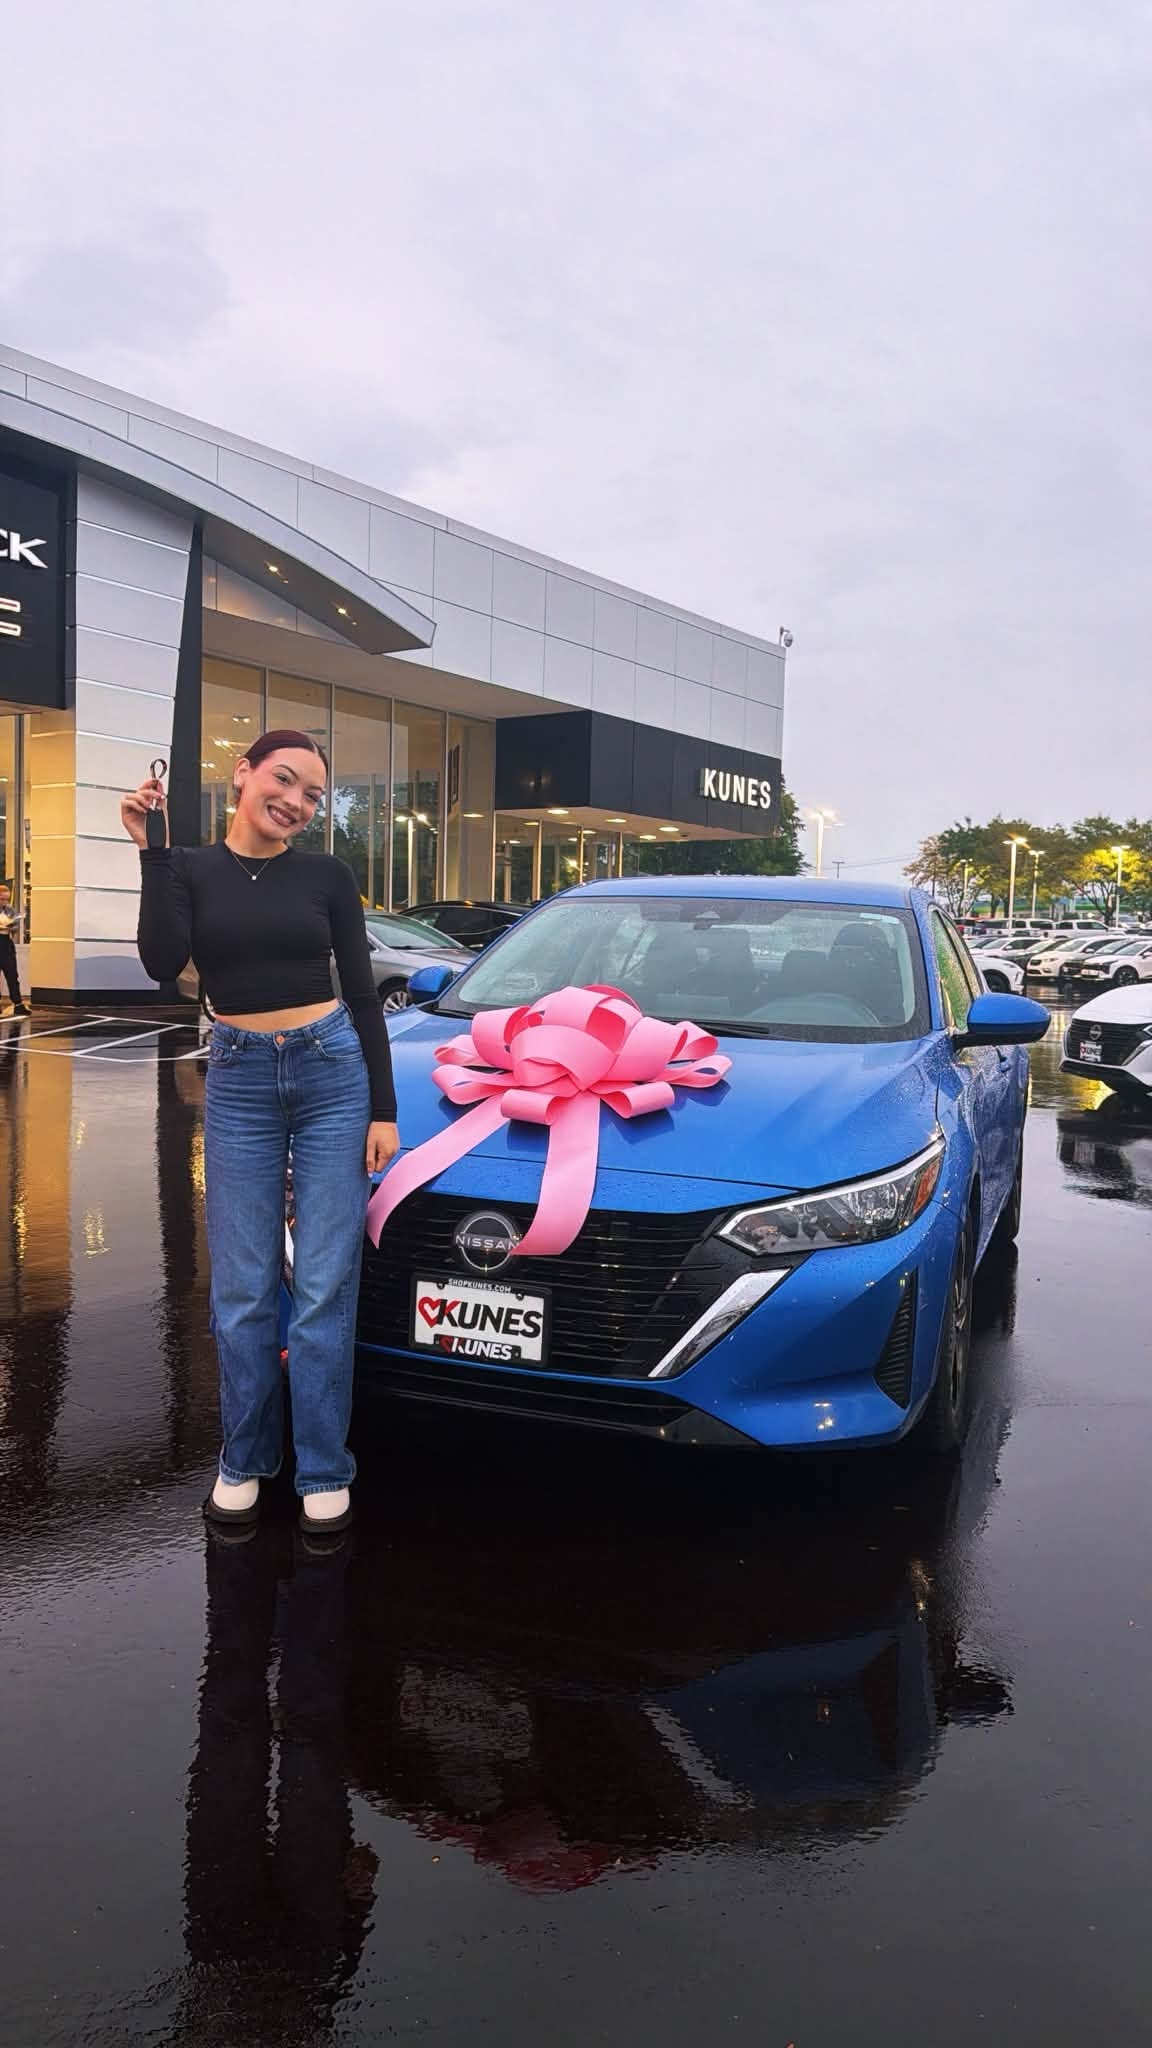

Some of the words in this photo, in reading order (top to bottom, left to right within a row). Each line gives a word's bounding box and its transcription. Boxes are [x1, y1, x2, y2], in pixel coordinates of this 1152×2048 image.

[704, 767, 771, 809] KUNES
[455, 1234, 520, 1250] NISSAN
[448, 1278, 512, 1294] SHOPKUNES.COM
[436, 1298, 543, 1338] KUNES
[451, 1337, 513, 1361] KUNES
